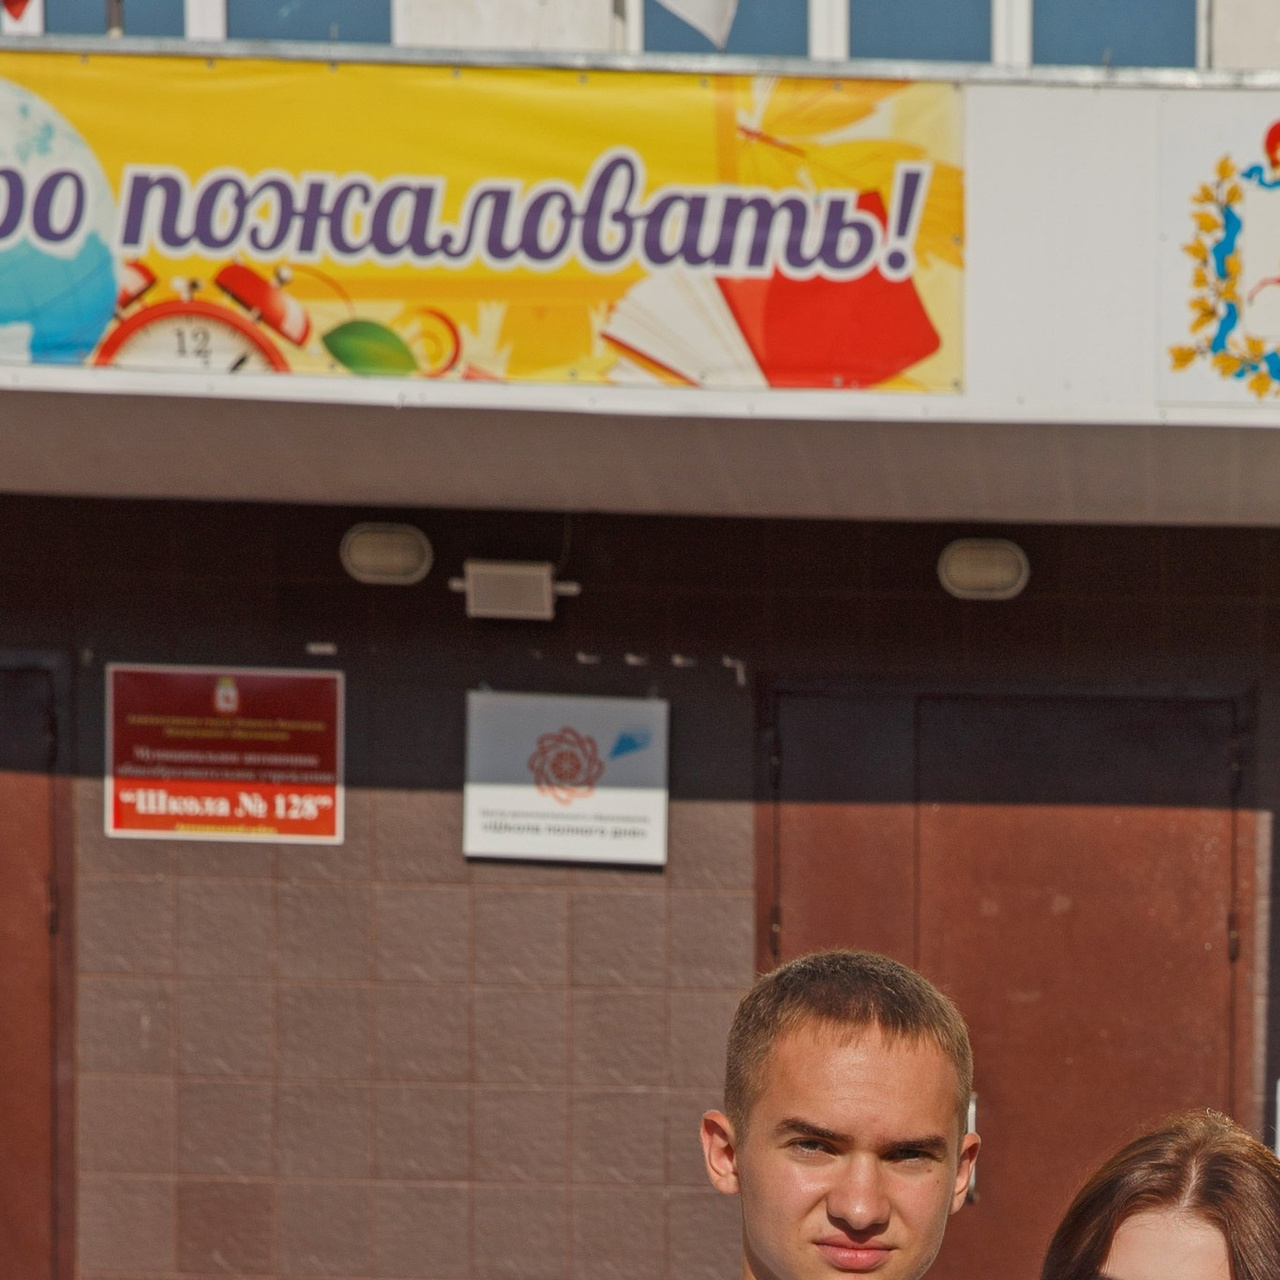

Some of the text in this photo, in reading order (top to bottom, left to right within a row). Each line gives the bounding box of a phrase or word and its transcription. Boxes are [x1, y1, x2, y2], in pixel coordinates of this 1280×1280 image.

[122, 156, 921, 269] пожаловать!
[174, 326, 210, 358] 12
[234, 792, 268, 818] №
